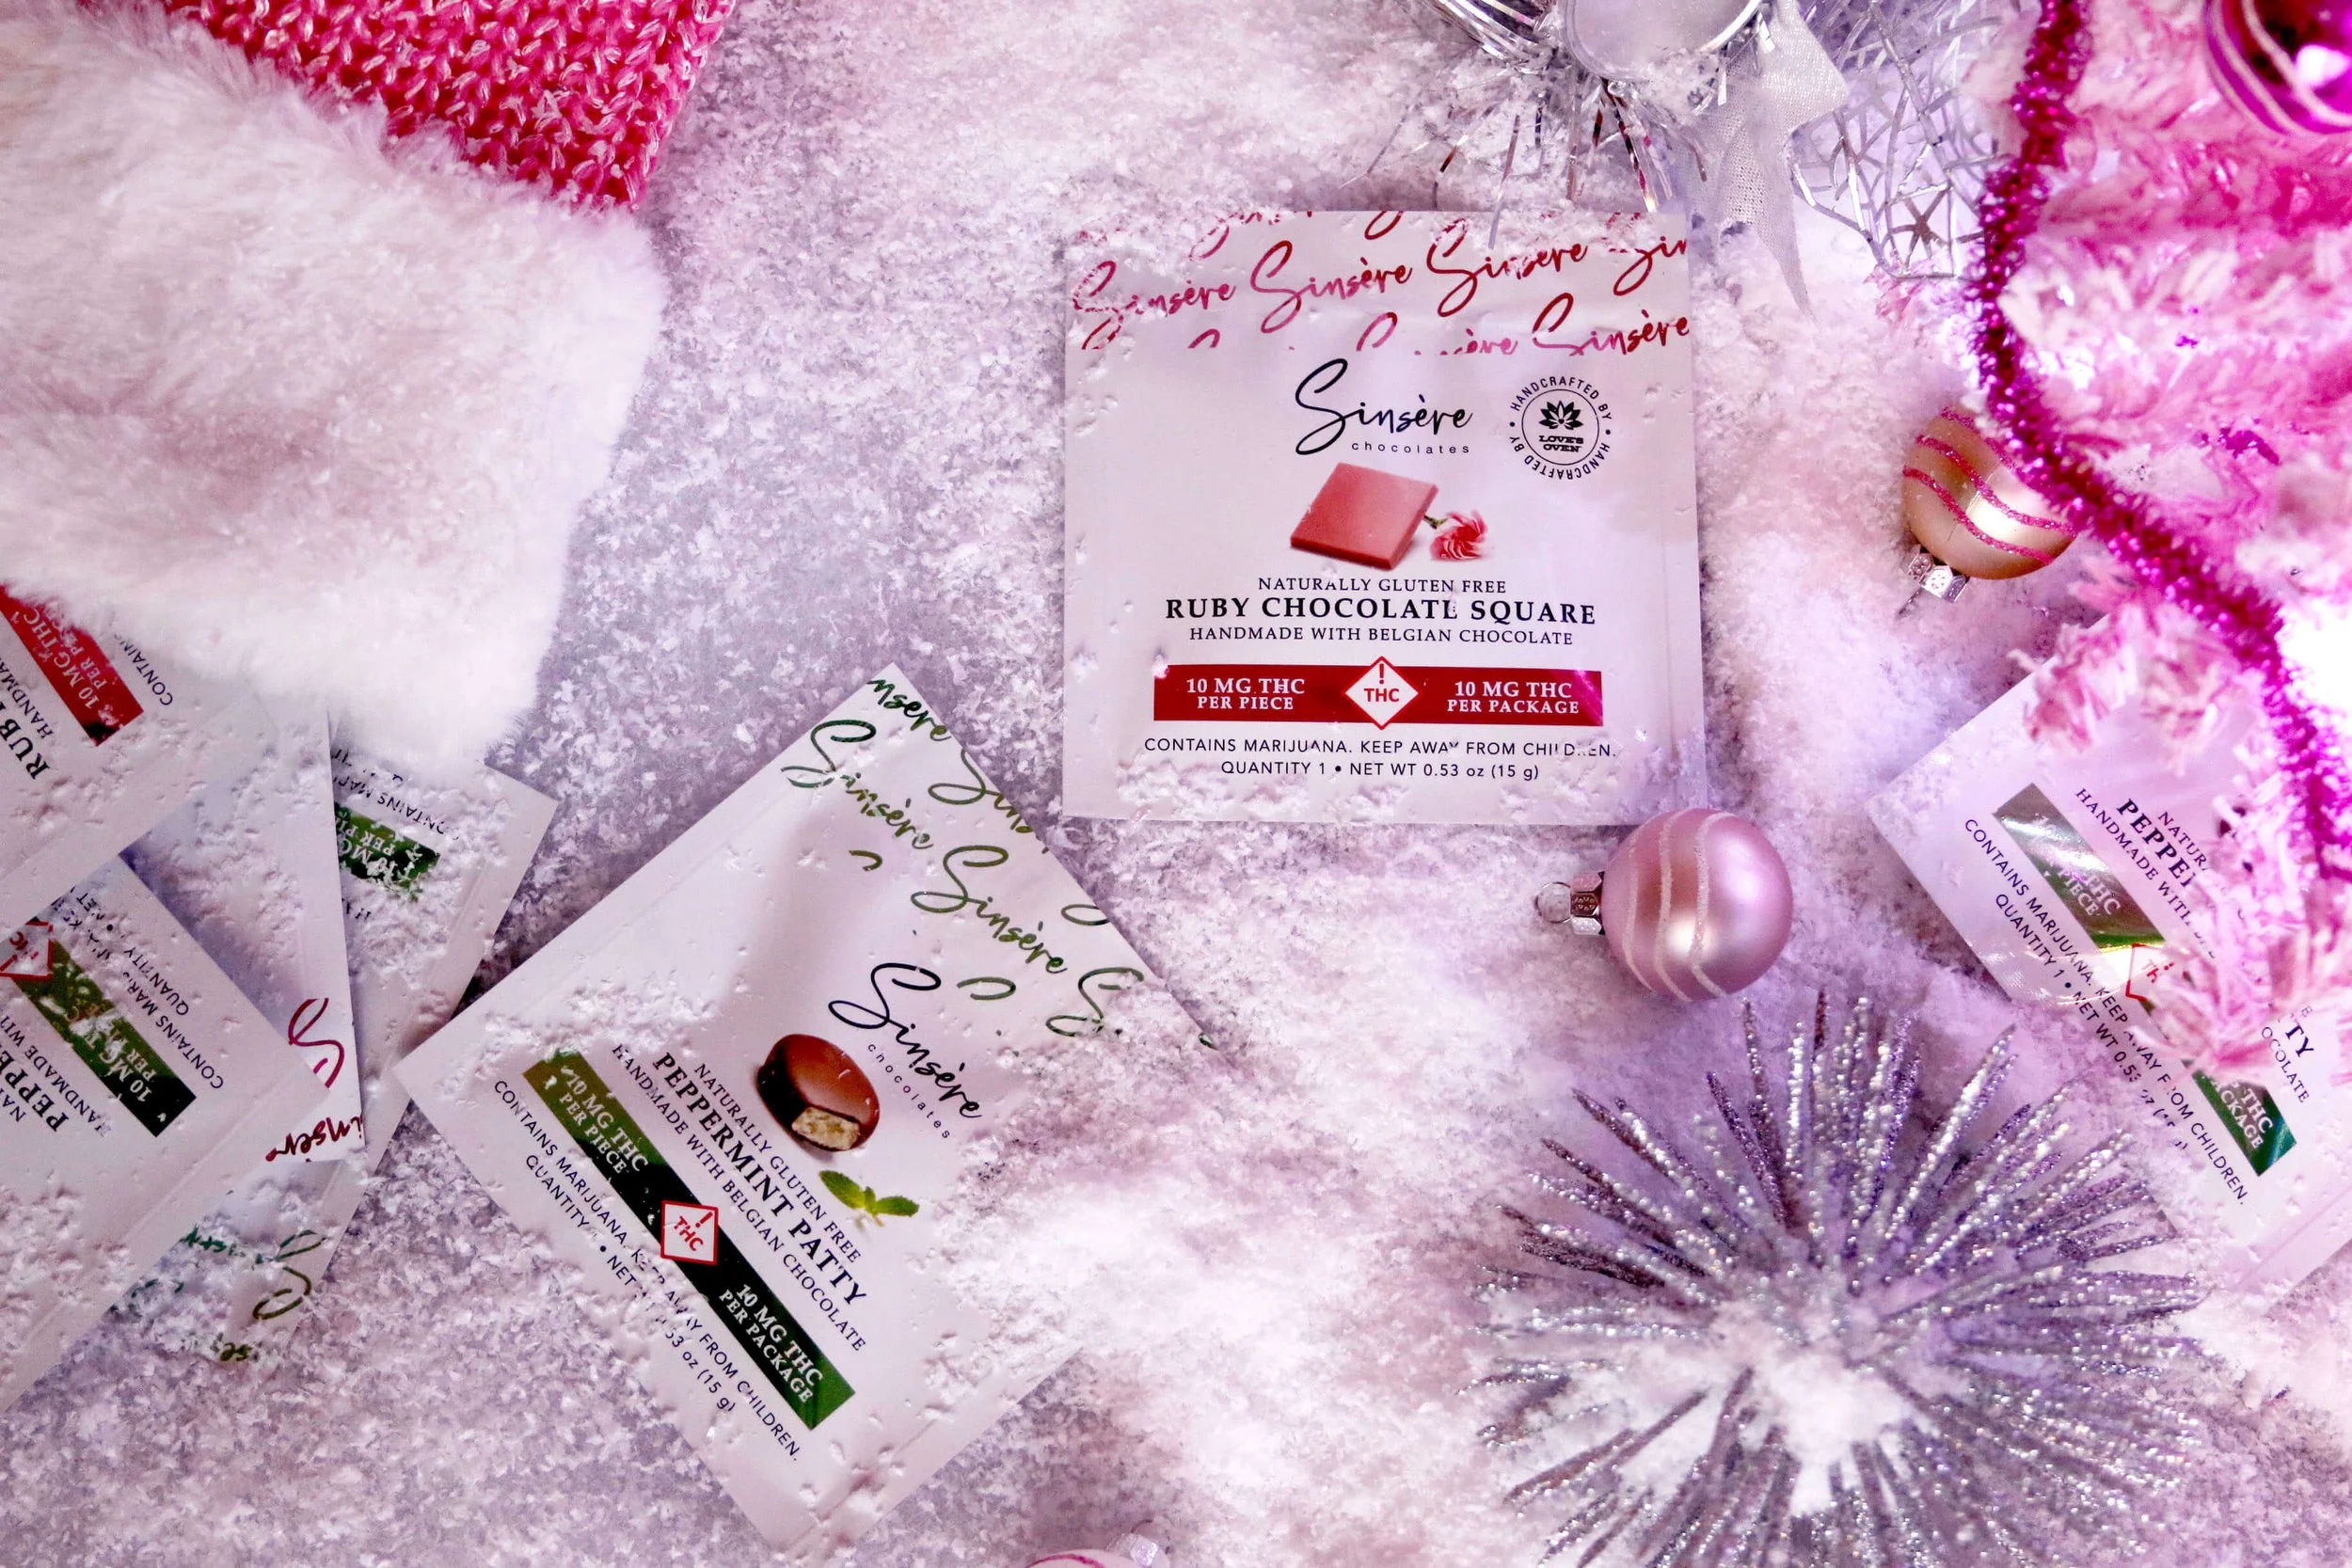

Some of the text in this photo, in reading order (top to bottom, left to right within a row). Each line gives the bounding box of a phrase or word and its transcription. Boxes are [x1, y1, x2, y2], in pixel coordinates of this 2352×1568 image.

[1250, 240, 1412, 333] Sinsère
[1295, 357, 1474, 456] Sinsère
[1510, 375, 1613, 420] HANDCRAFTED BY
[1351, 440, 1471, 454] chocolates
[1509, 436, 1611, 480] HANDCRAFTED BY
[1543, 443, 1581, 452] OVEN
[1165, 597, 1597, 626] RUBY CHOCOLATE SQUARE
[1258, 577, 1506, 594] NATURALLY GLUTEN FREE
[21, 607, 100, 709] 10 MG THC
[78, 657, 107, 689] PER
[110, 627, 176, 705] CONTAIN
[1189, 626, 1574, 645] HANDMADE WITH BELGIAN CHOCOLATE
[1186, 678, 1306, 695] 10 MG THC
[1197, 695, 1294, 710] PER PIECE
[1363, 688, 1401, 704] THC
[1447, 699, 1580, 715] PER PACKAGE
[1454, 681, 1572, 699] 10 MG THC
[1, 702, 49, 778] RUB
[1144, 738, 1237, 752] CONTAINS
[1244, 738, 1353, 754] MARIJUANA.
[1360, 740, 1404, 754] KEEP
[1466, 741, 1516, 756] FROM
[1221, 761, 1539, 782] QUANTITY 1 NET WT 0.53 oz (15 g)
[359, 831, 395, 856] PER
[2075, 788, 2157, 879] HANDMADE
[913, 845, 1067, 975] Sinsère
[1993, 893, 2057, 968] QUANTITY
[2093, 1023, 2119, 1051] WT
[830, 962, 982, 1121] Sinsère
[1963, 817, 2029, 895] CONTAINS
[2094, 986, 2128, 1025] KEEP
[2189, 1121, 2250, 1204] CHILDREN.
[126, 1048, 156, 1080] PER
[127, 1076, 153, 1103] 10
[155, 1015, 225, 1089] CONTAINS
[2260, 1025, 2310, 1102] OCOLATE
[564, 1073, 648, 1172] 10 MG THC
[867, 1041, 951, 1140] chocolates
[2239, 1088, 2273, 1132] THC
[559, 1093, 628, 1173] PER PIECE
[692, 1063, 861, 1263] NATURALLY GLUTEN FREE
[651, 1052, 867, 1307] PEPPERMINT PATTY
[492, 1079, 558, 1156] CONTAINS
[555, 1157, 633, 1247] MARIJUANA.
[699, 1334, 738, 1378] FROM
[735, 1379, 803, 1461] CHILDREN.
[671, 1216, 704, 1251] THC
[684, 1133, 725, 1180] WITH
[721, 1179, 785, 1253] BELGIAN
[781, 1251, 866, 1352] CHOCOLATE
[523, 1153, 590, 1230] QUANTITY
[606, 1256, 635, 1287] NET
[681, 1350, 699, 1369] oz
[696, 1368, 722, 1396] (15
[719, 1290, 812, 1402] PER PACKAGE
[735, 1283, 823, 1386] 10 MG THC
